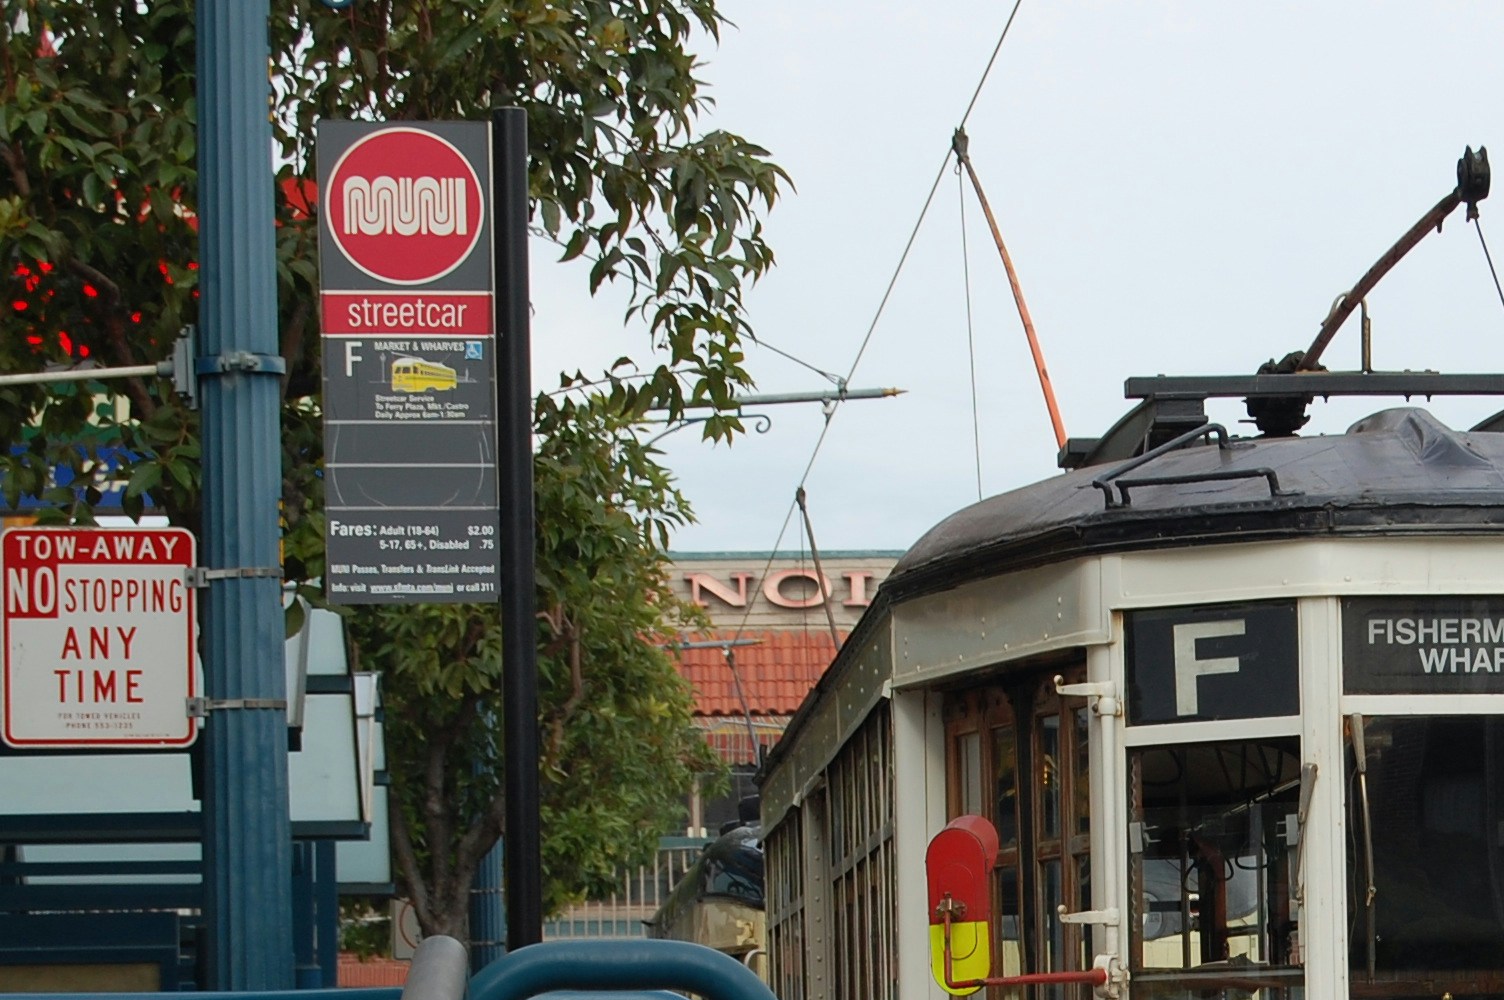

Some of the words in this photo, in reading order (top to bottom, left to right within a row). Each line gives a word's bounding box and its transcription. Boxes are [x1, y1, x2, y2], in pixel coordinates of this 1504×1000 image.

[348, 298, 468, 328] streetcar
[344, 341, 363, 377] F
[374, 341, 410, 351] MARKET
[412, 341, 419, 351] &
[420, 341, 465, 352] WHARVES
[330, 521, 378, 536] Fares:
[379, 525, 405, 536] Adult
[467, 525, 494, 536] $2.00
[15, 535, 179, 560] TOW-AWAY
[429, 540, 470, 550] Disabled
[479, 540, 494, 550] .75
[461, 564, 495, 575] Accepted
[8, 566, 57, 614] NO
[65, 578, 183, 613] STOPPING
[481, 582, 494, 592] 311
[61, 626, 137, 660] ANY
[1172, 618, 1247, 717] F
[54, 670, 144, 703] TIME
